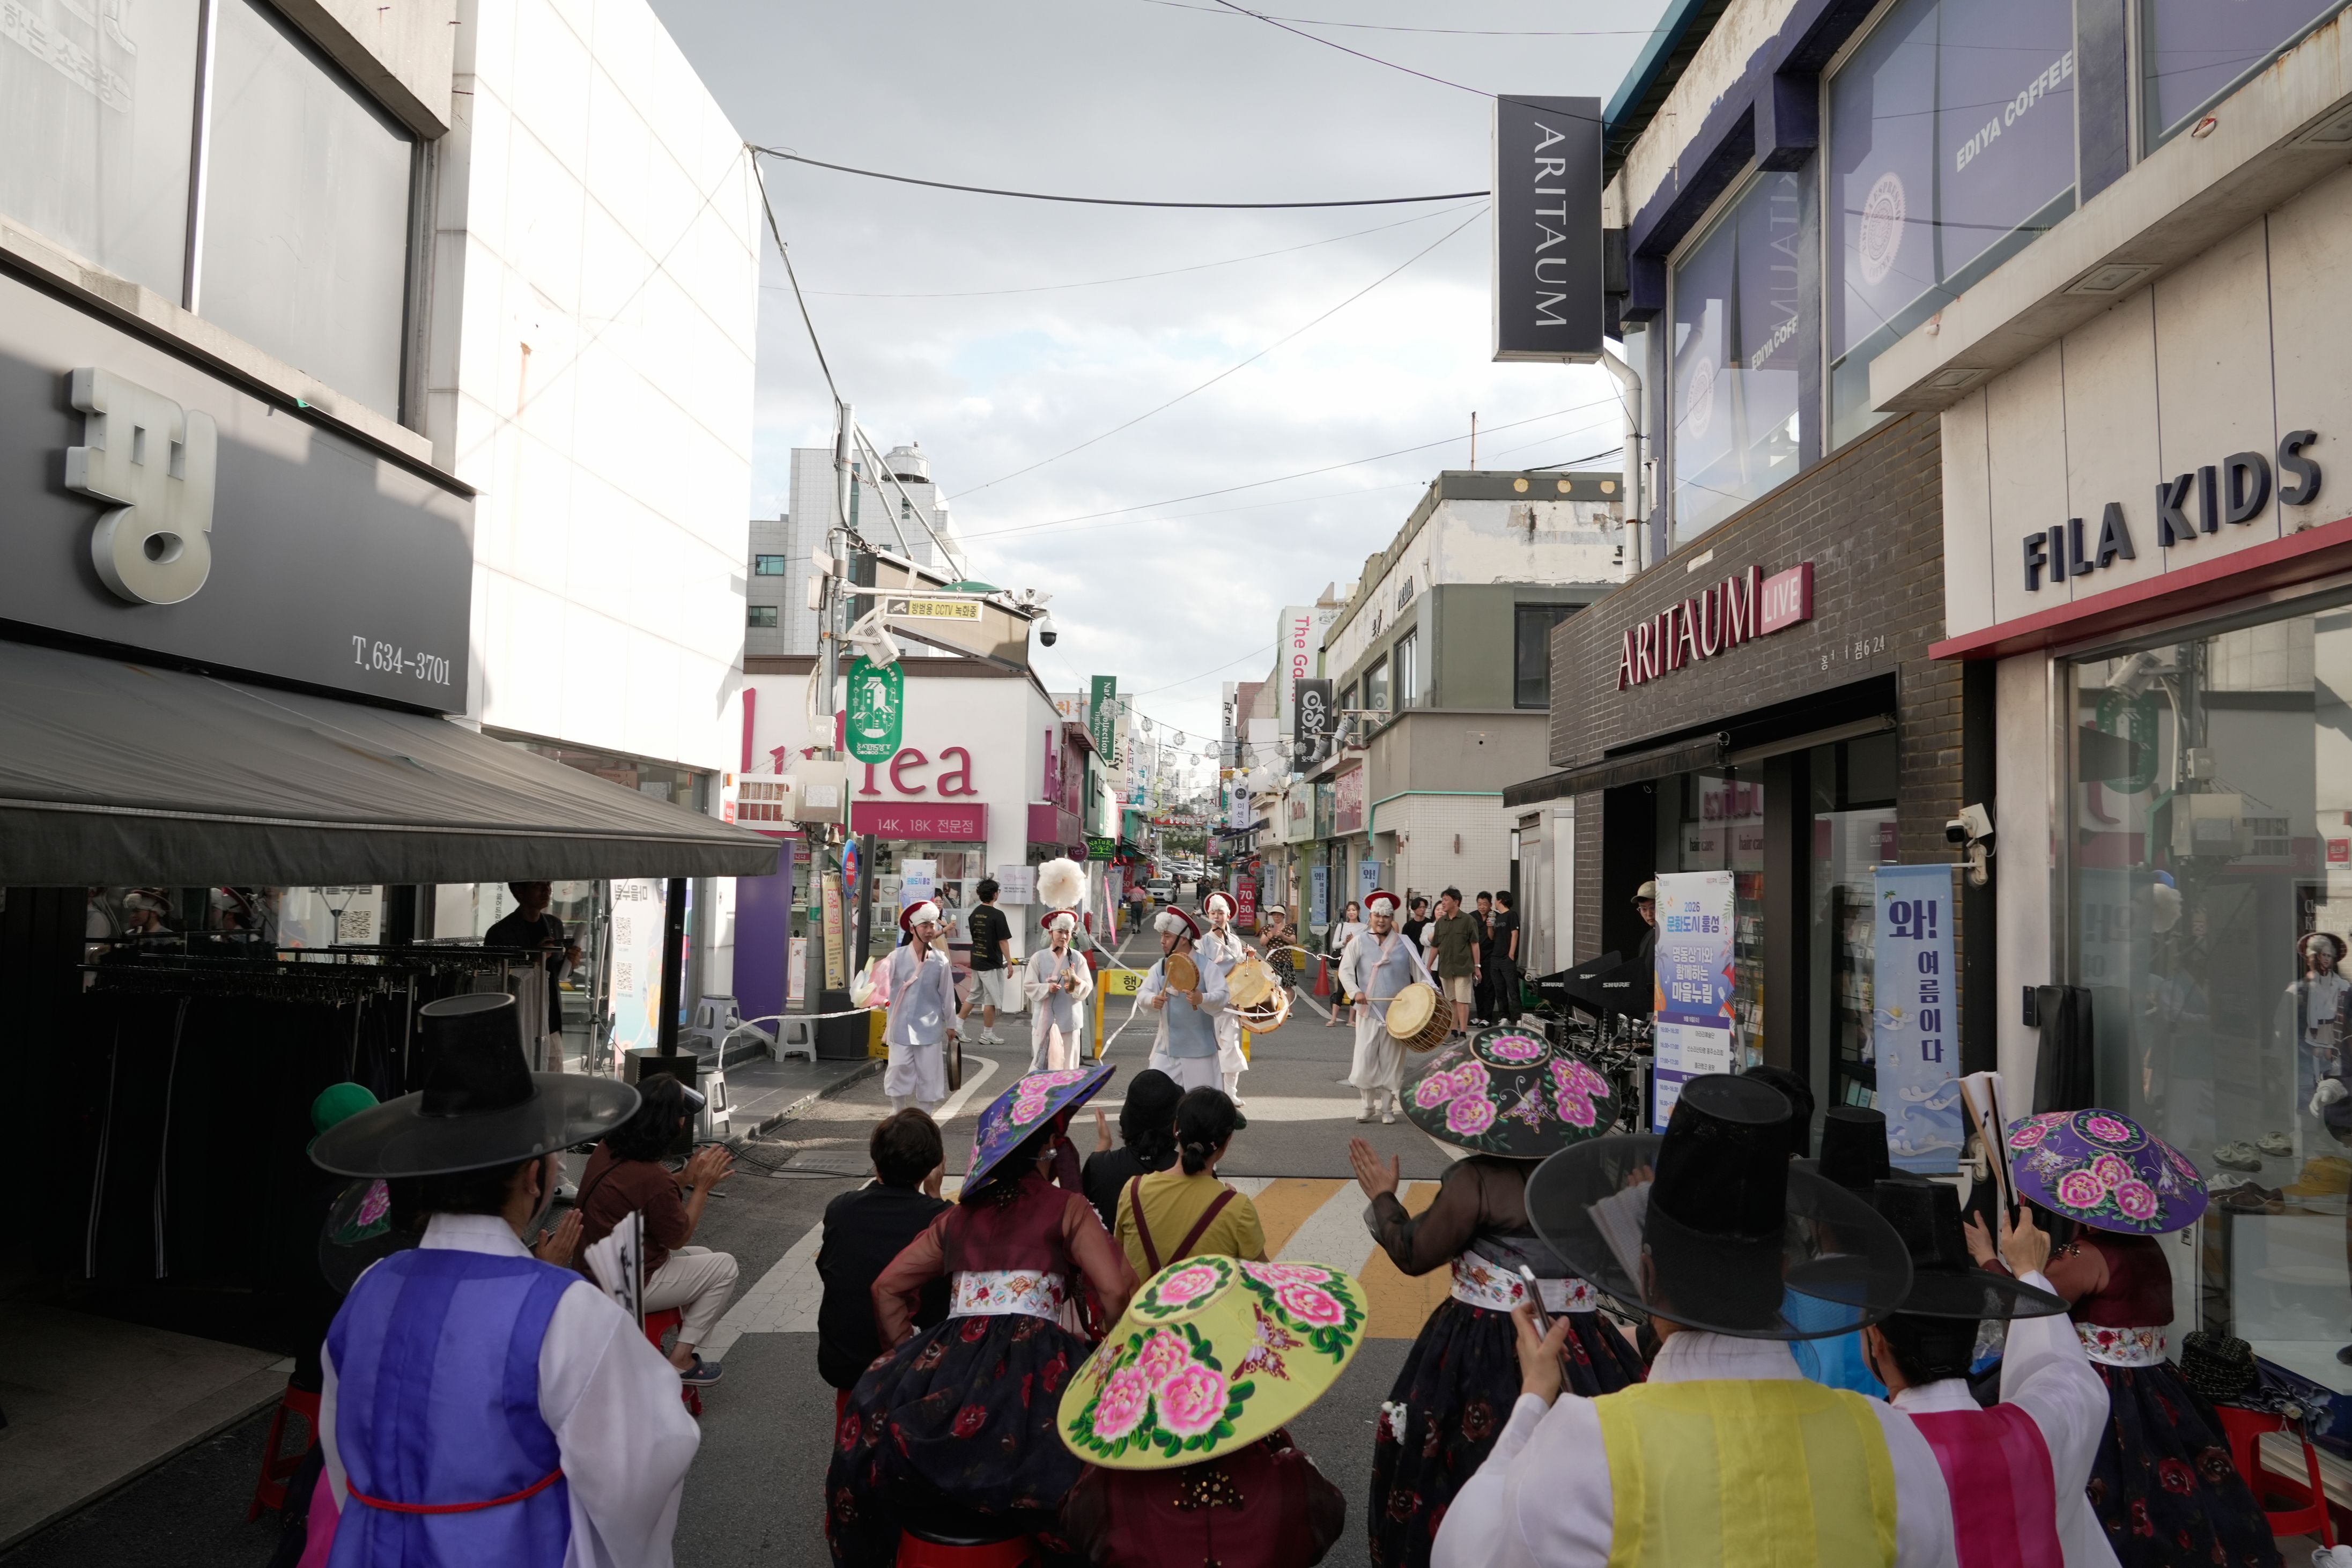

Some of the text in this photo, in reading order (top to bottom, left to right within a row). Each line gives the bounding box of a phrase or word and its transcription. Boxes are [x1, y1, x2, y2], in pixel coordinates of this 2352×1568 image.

[1957, 49, 2073, 172] EDIYA COFFEE
[1534, 121, 1567, 326] ARITAUM
[1752, 314, 1798, 371] EDIYA COFF
[2023, 430, 2322, 591] FILA KIDS
[912, 603, 977, 617] 방범용 CCTV 녹화중
[1295, 616, 1310, 648] The
[1617, 566, 1799, 691] ARITAUM LIVE
[1236, 803, 1244, 826] 미센스
[877, 819, 974, 833] 14K, 18K 전문점
[1690, 837, 1714, 852] hair care
[1739, 834, 1764, 850] hair car
[1870, 835, 1880, 843] OUT
[1684, 901, 1700, 912] 2026
[2304, 899, 2334, 914] Classic
[1667, 915, 1720, 933] 문화도시 홍성
[1888, 900, 1937, 940] 와!
[1672, 946, 1714, 964] 명동상가와
[1675, 964, 1709, 982] 함께하는
[1672, 981, 1713, 1004] 마을누림
[1918, 950, 1944, 1063] 여름이다
